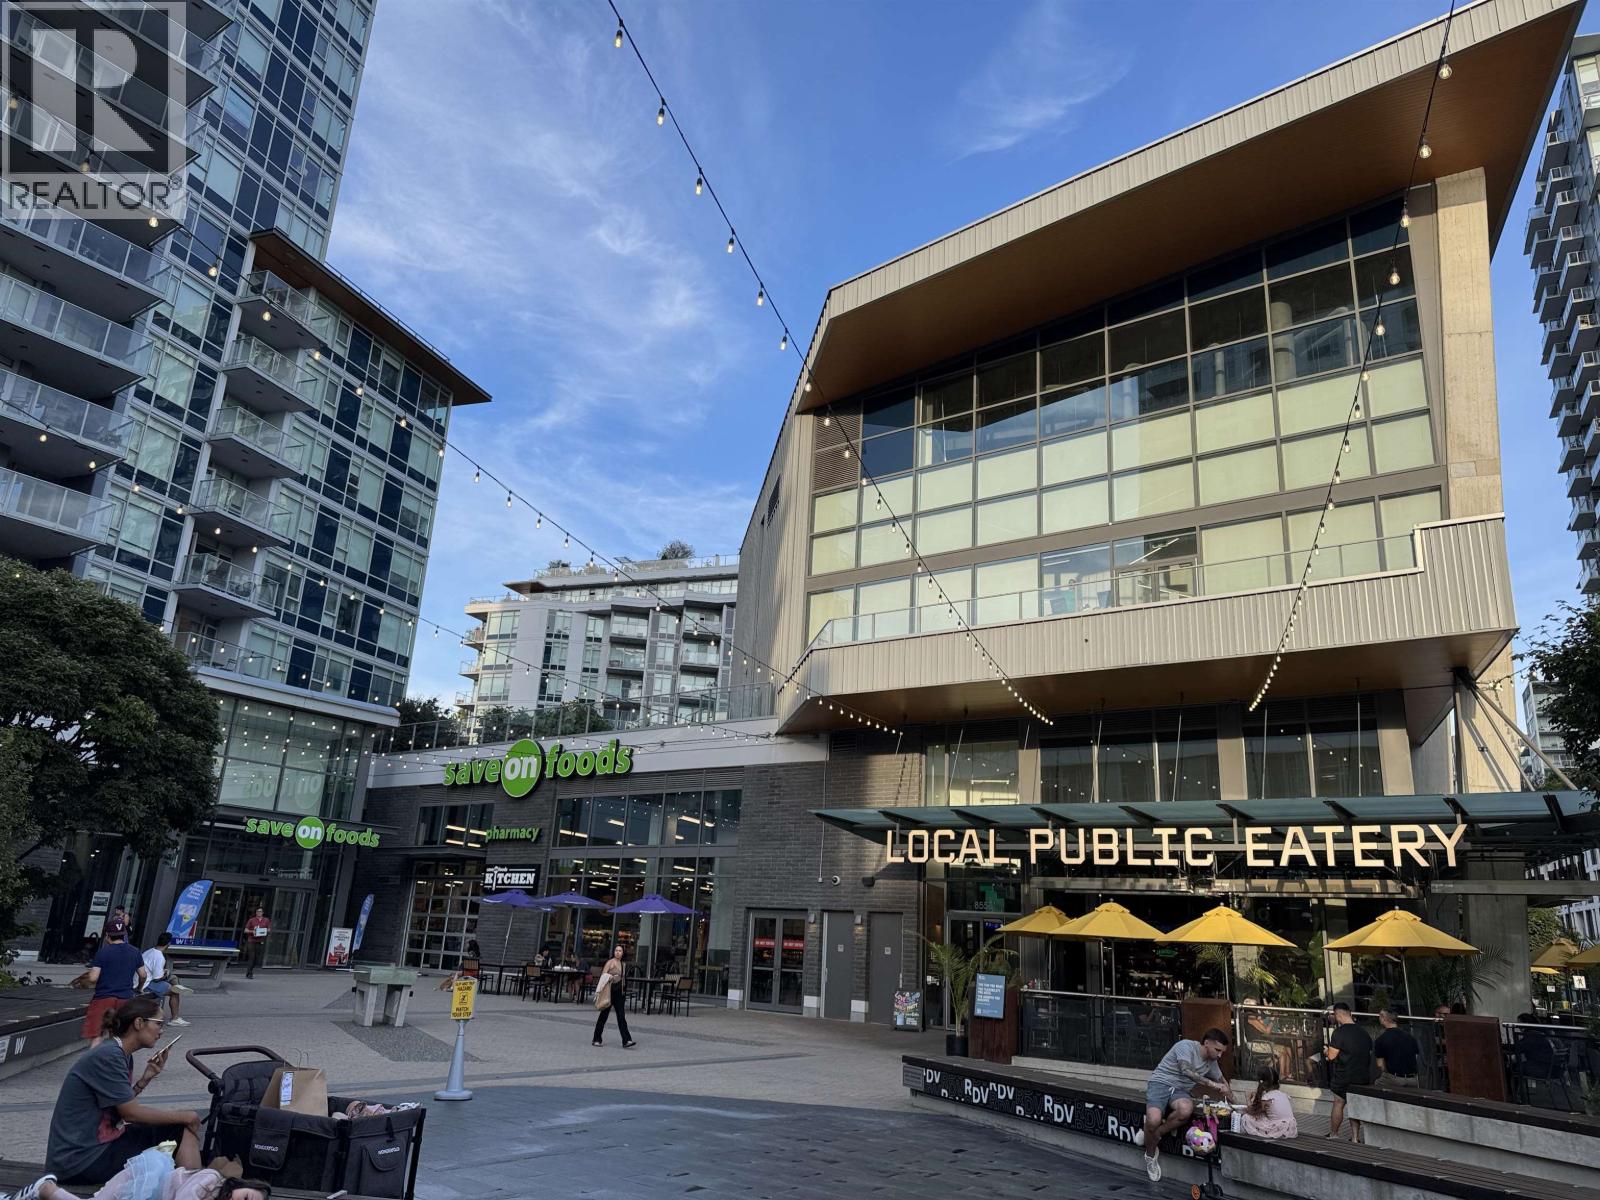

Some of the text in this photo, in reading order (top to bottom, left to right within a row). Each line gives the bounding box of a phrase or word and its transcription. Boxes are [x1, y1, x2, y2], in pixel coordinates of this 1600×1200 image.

[443, 738, 633, 786] save on foods
[245, 818, 380, 848] save on foods
[485, 826, 539, 843] pharmacy
[886, 824, 1467, 867] LOCAL PUBLIC EATERY
[484, 873, 536, 887] KITCHEN
[923, 1068, 941, 1083] DV
[964, 1078, 989, 1104] RDV
[1044, 1094, 1075, 1124] RDV
